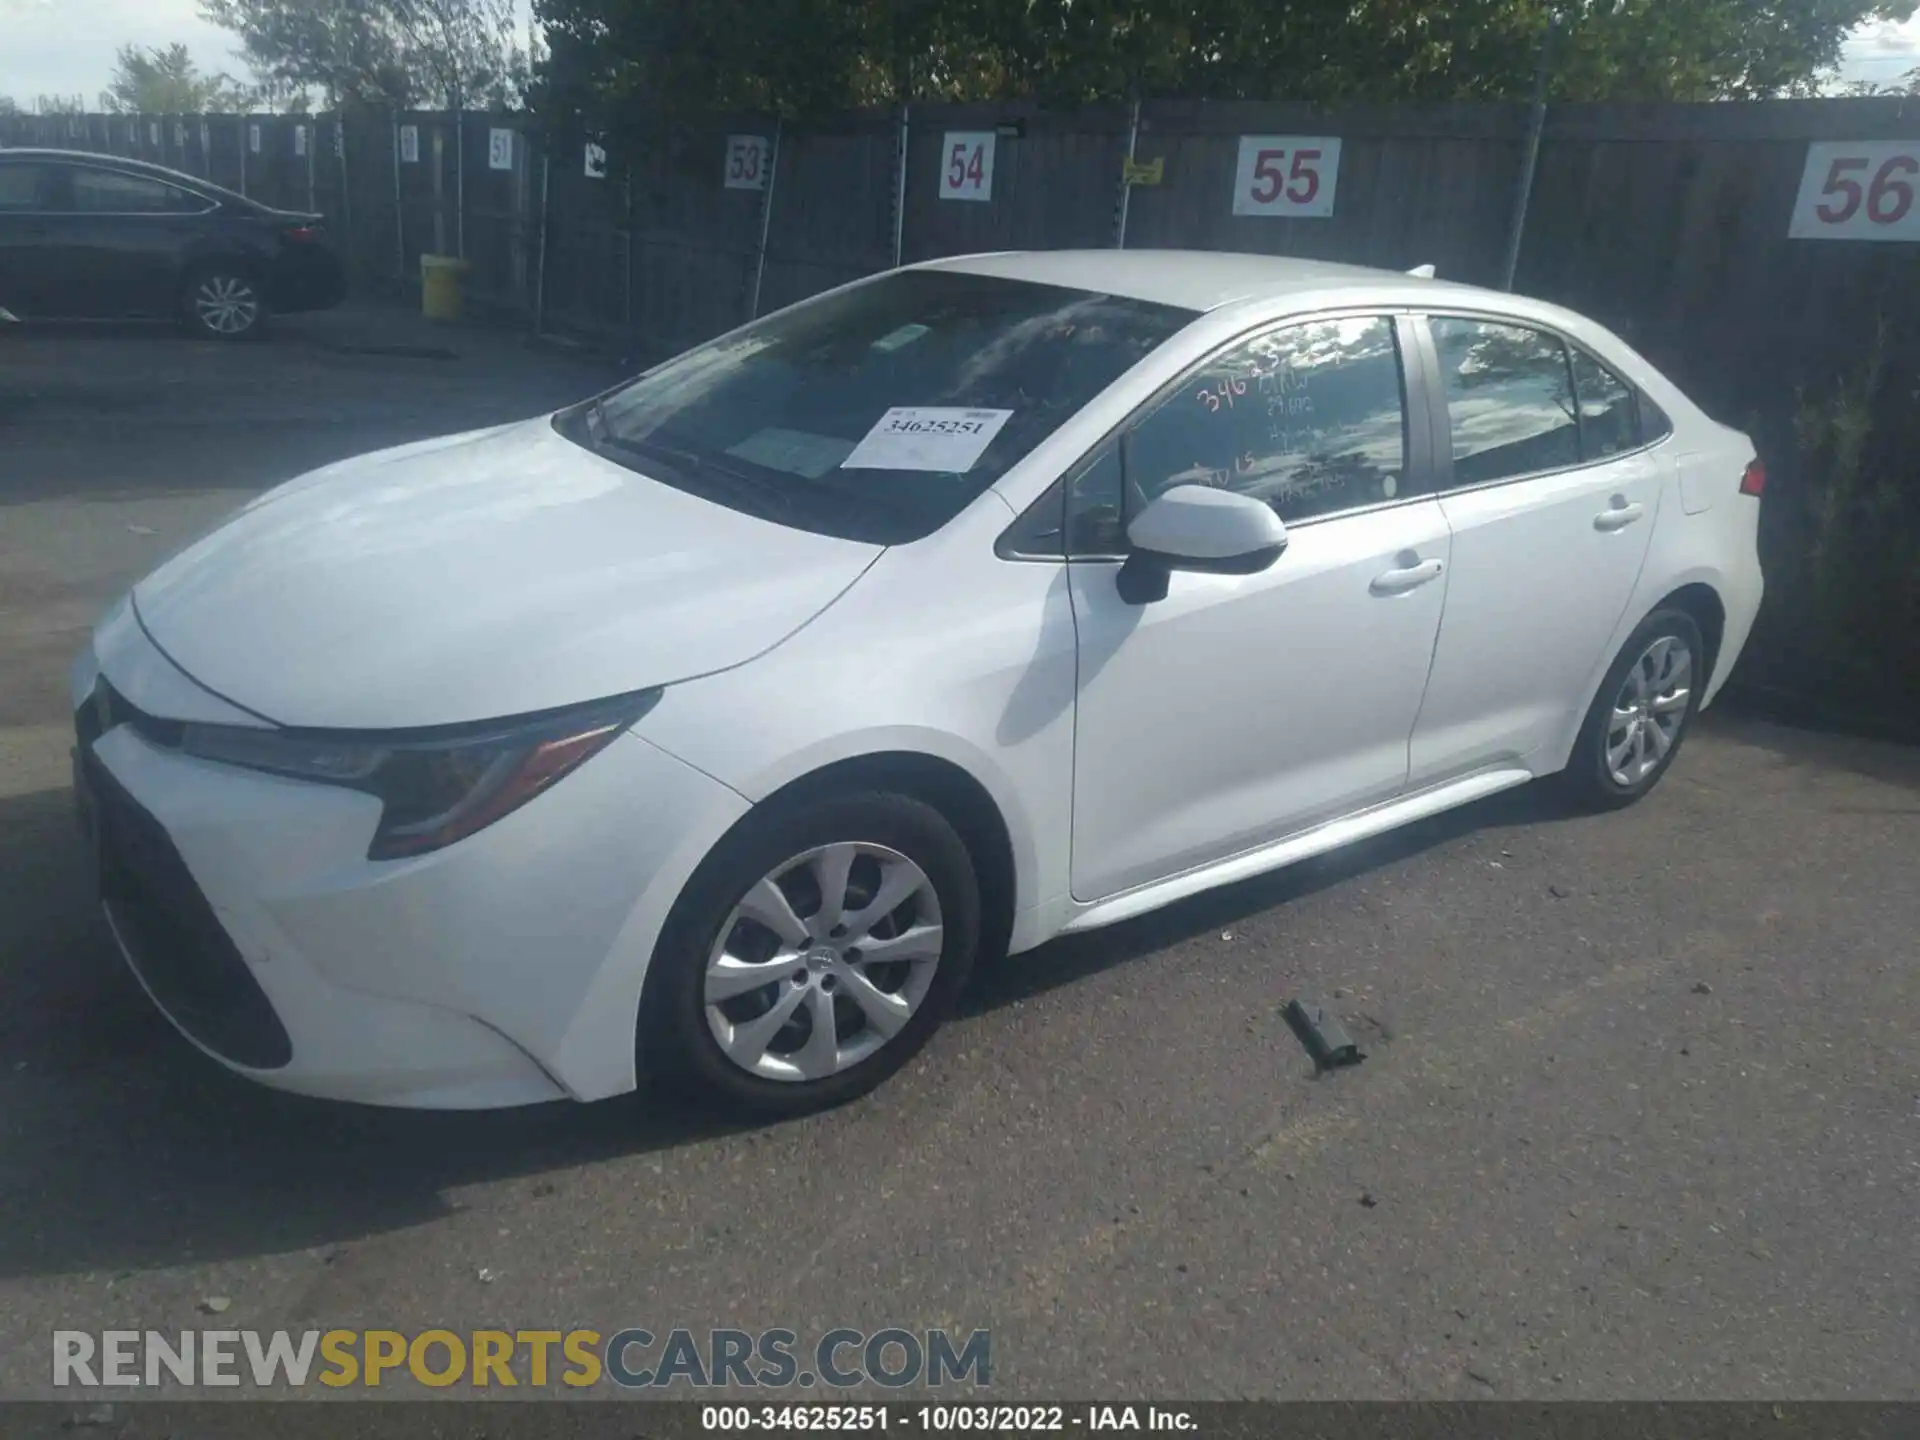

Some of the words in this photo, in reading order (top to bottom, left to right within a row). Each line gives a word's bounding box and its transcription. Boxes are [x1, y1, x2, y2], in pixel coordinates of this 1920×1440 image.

[731, 145, 760, 181] 53
[948, 143, 985, 188] 54
[1251, 150, 1321, 204] 55
[1816, 155, 1920, 224] 56
[884, 418, 985, 435] 34625251
